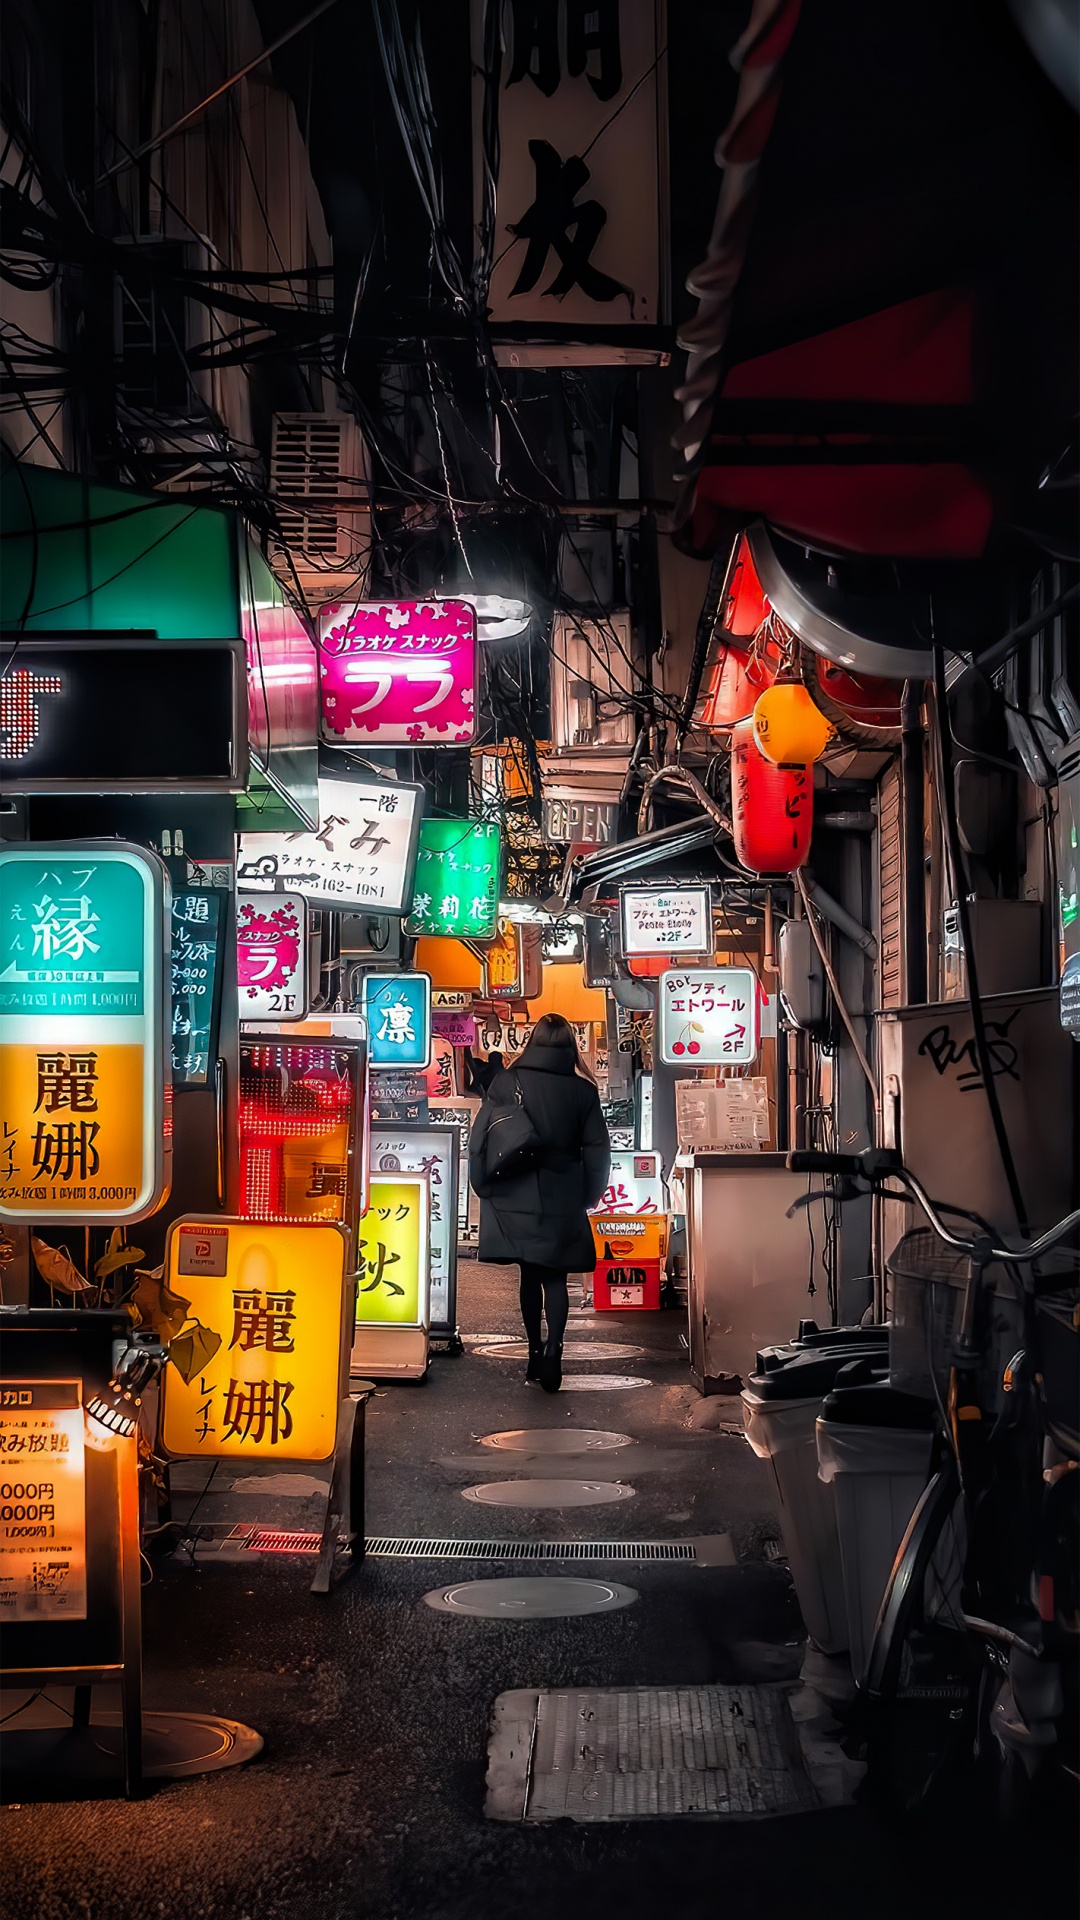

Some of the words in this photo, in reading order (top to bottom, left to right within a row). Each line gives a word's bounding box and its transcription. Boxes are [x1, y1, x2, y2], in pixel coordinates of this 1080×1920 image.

[399, 634, 458, 649] スナック
[344, 659, 454, 714] ララ
[359, 794, 398, 813] 一階
[285, 815, 391, 856] ぐみ
[474, 824, 495, 838] 2F
[31, 894, 101, 960] 縁
[238, 932, 281, 943] スナック
[268, 994, 296, 1012] 2F
[437, 993, 465, 1005] Ash
[671, 999, 745, 1013] エトワール
[722, 1041, 744, 1053] 2F
[31, 1051, 101, 1181] 麗娜
[1, 1122, 20, 1181] レイナ
[220, 1288, 297, 1445] 麗娜
[195, 1377, 217, 1443] レイナ
